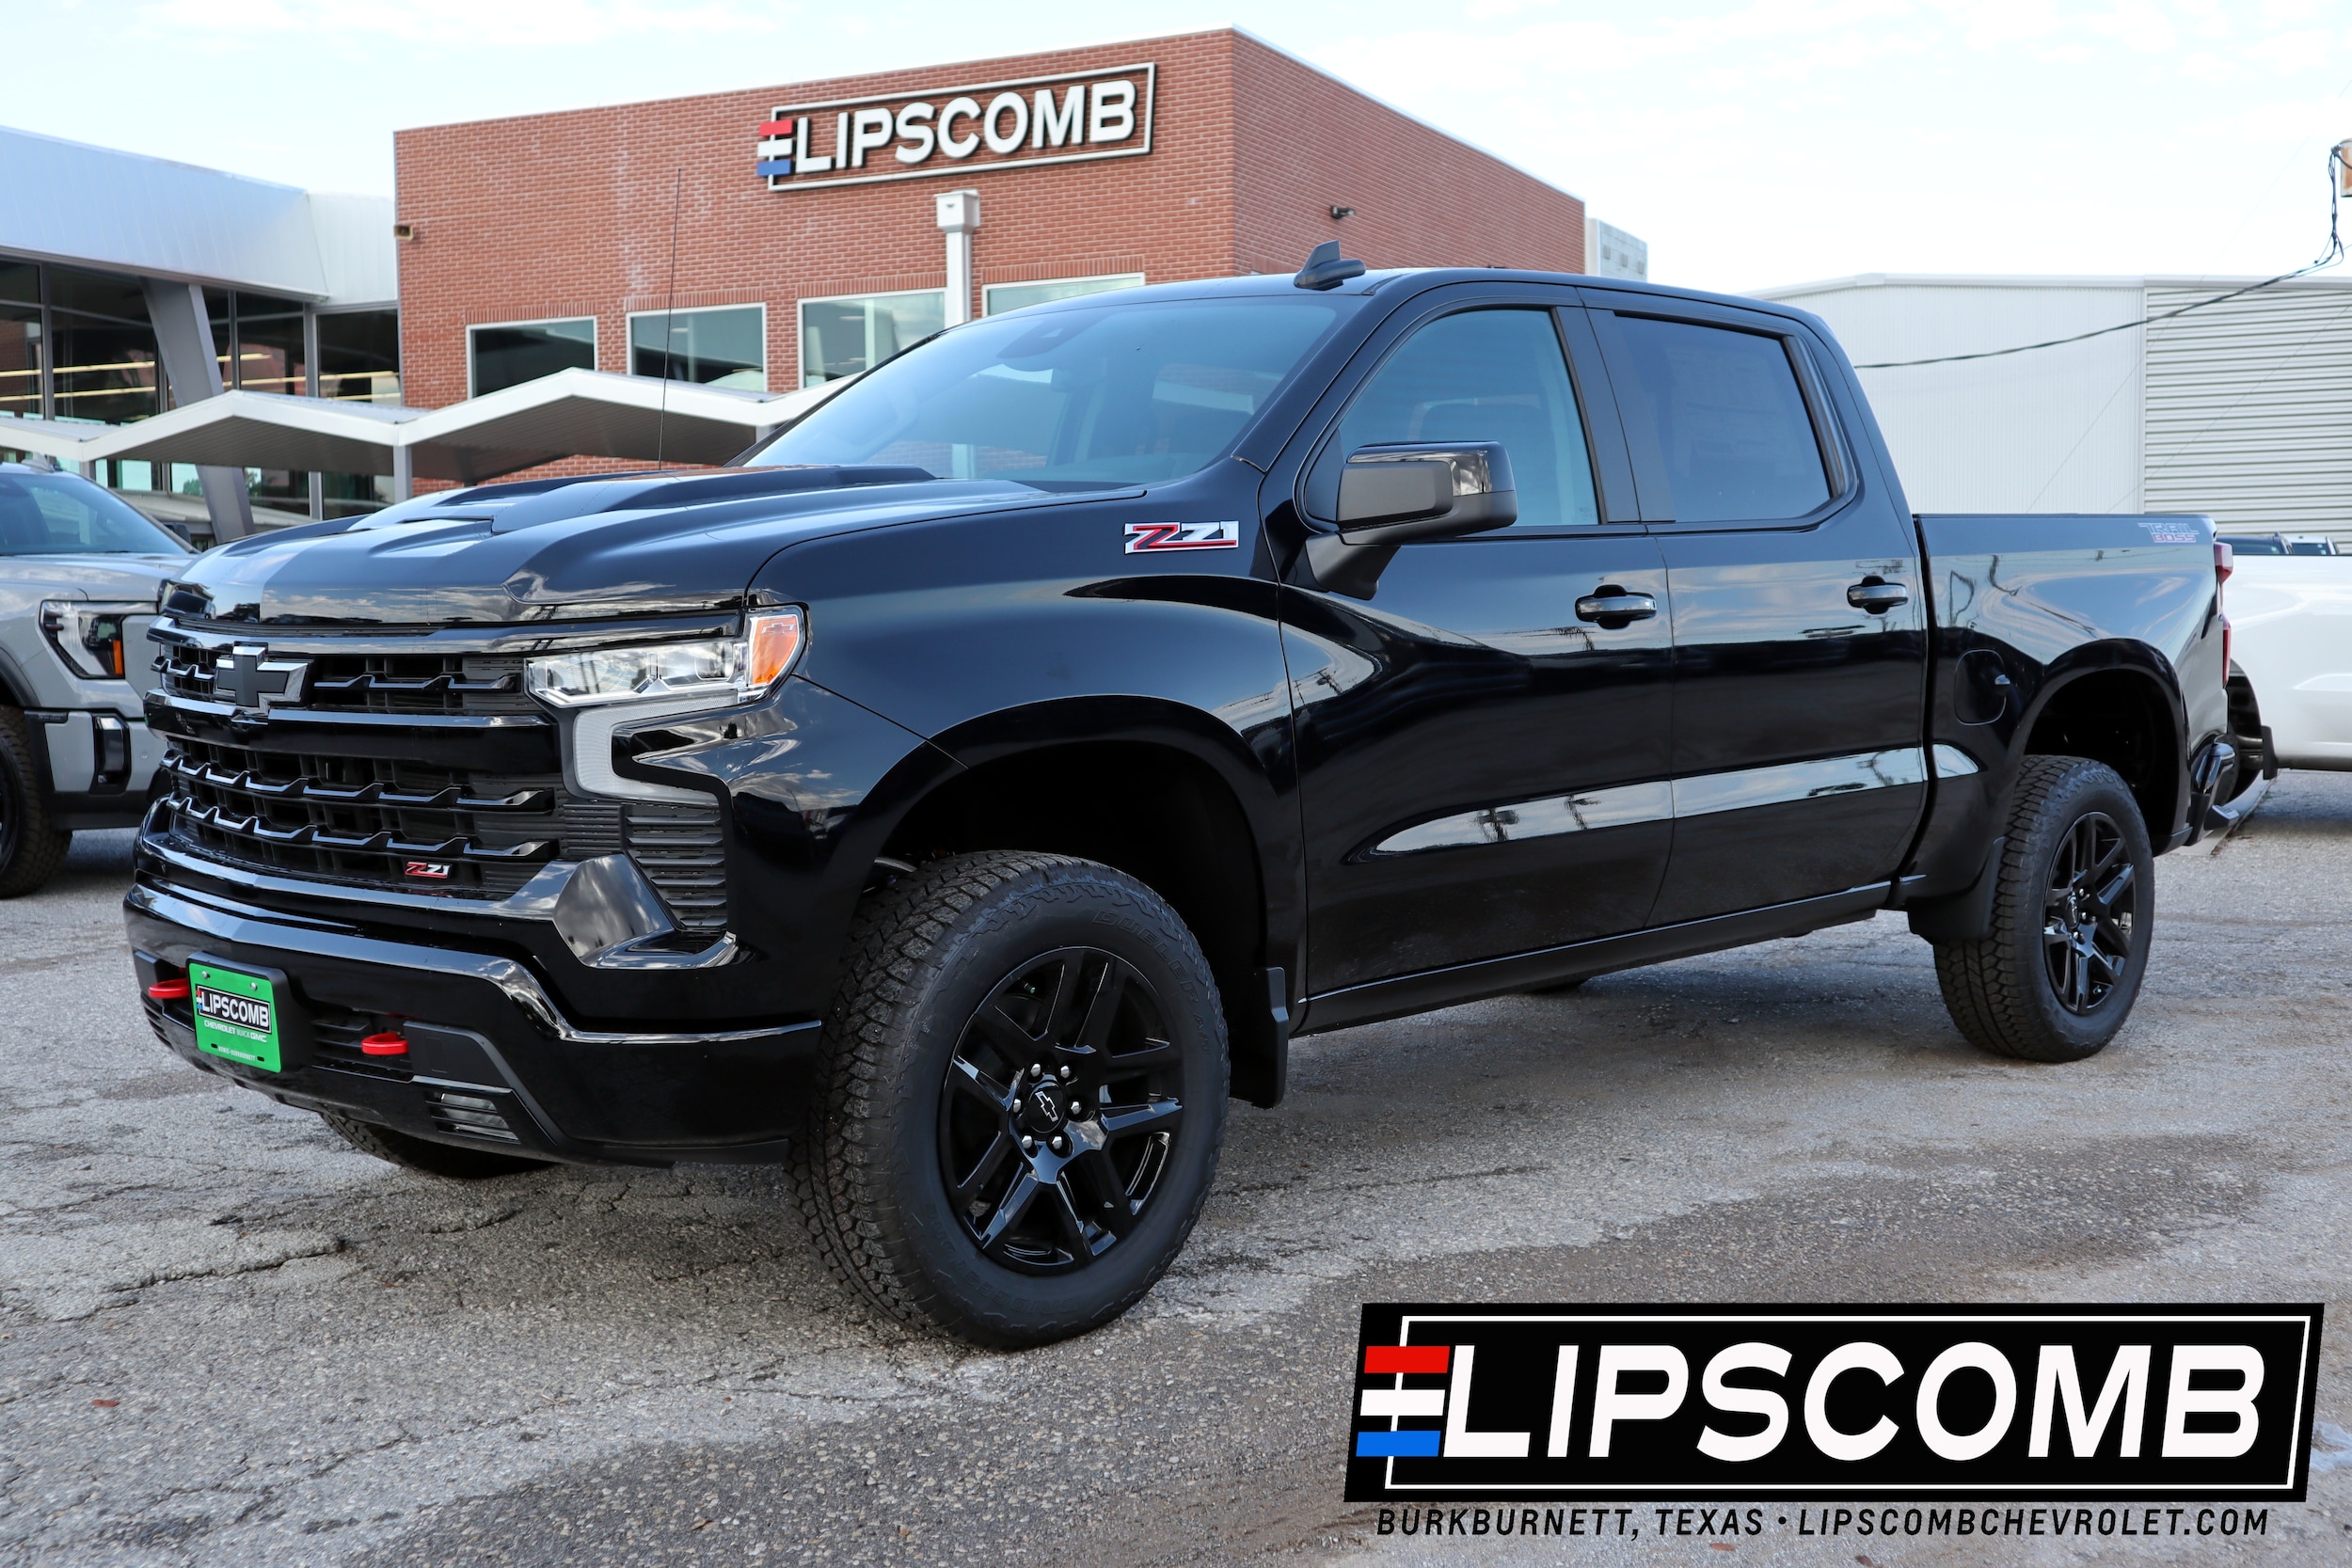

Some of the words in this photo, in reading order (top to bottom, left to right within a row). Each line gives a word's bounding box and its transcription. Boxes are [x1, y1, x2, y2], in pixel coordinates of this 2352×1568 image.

[795, 79, 1136, 174] LIPSCOMB
[1123, 520, 1239, 554] Z71
[2137, 523, 2200, 534] TRAIL
[2152, 533, 2197, 543] BOSS
[405, 862, 451, 879] Z71
[1091, 909, 1200, 1003] DUELER
[200, 990, 269, 1028] LIPSCOMB
[203, 1019, 236, 1035] CHEVROLET
[249, 1032, 267, 1043] GMC
